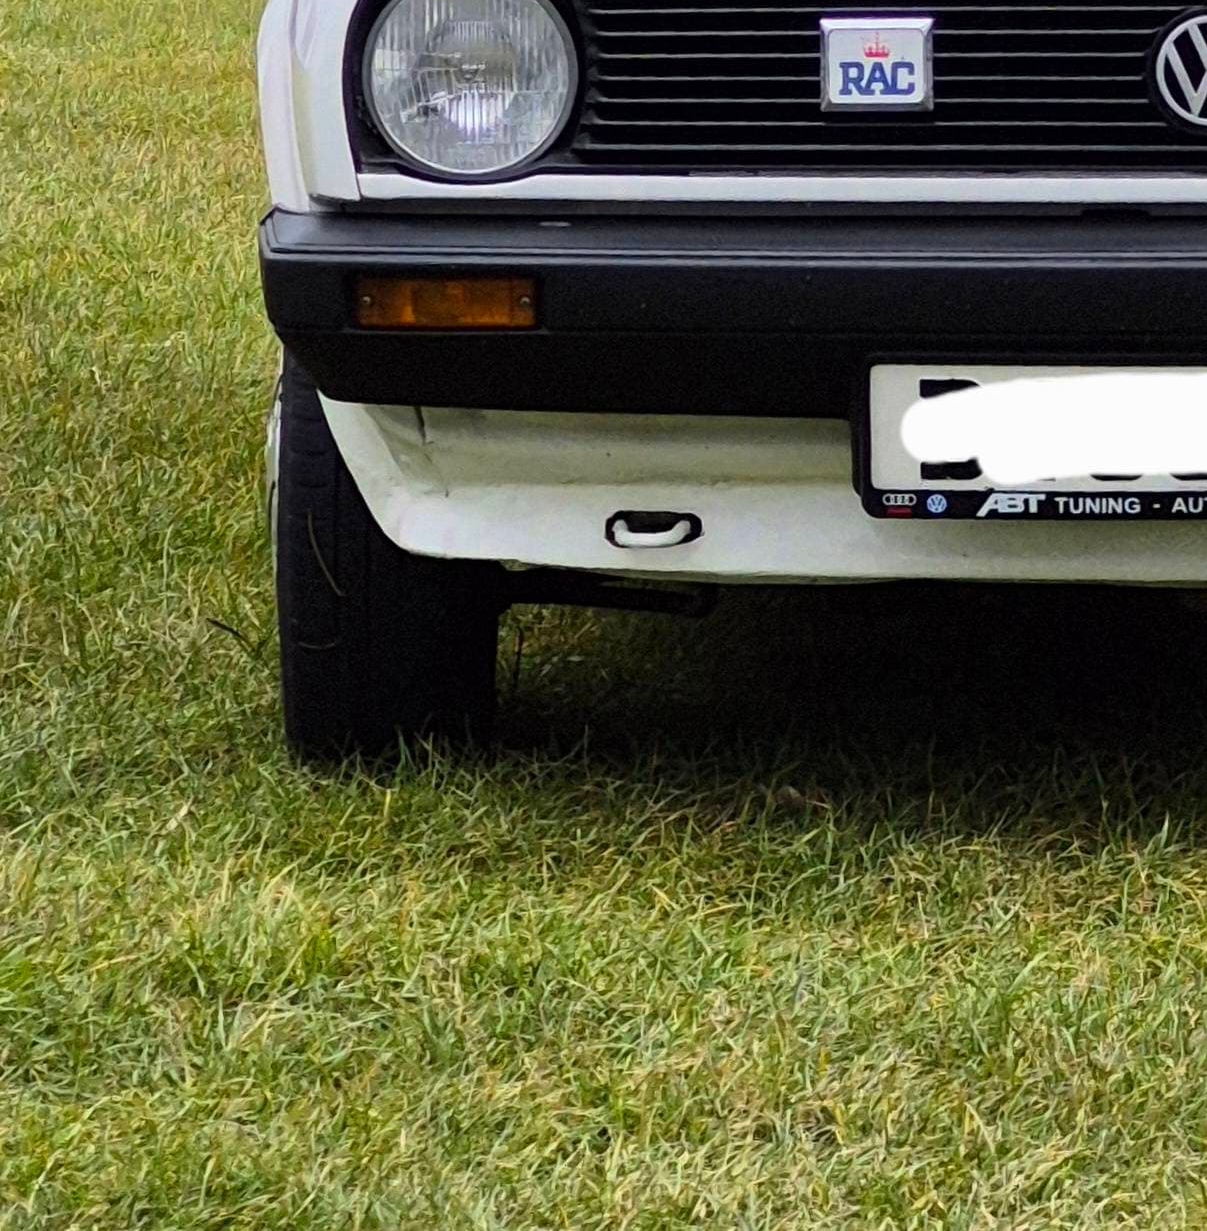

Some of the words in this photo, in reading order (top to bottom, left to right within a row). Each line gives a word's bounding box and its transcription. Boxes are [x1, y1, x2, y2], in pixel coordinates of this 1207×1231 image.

[839, 61, 915, 96] RAC
[976, 492, 1046, 517] ABT
[1054, 496, 1141, 514] TUNING
